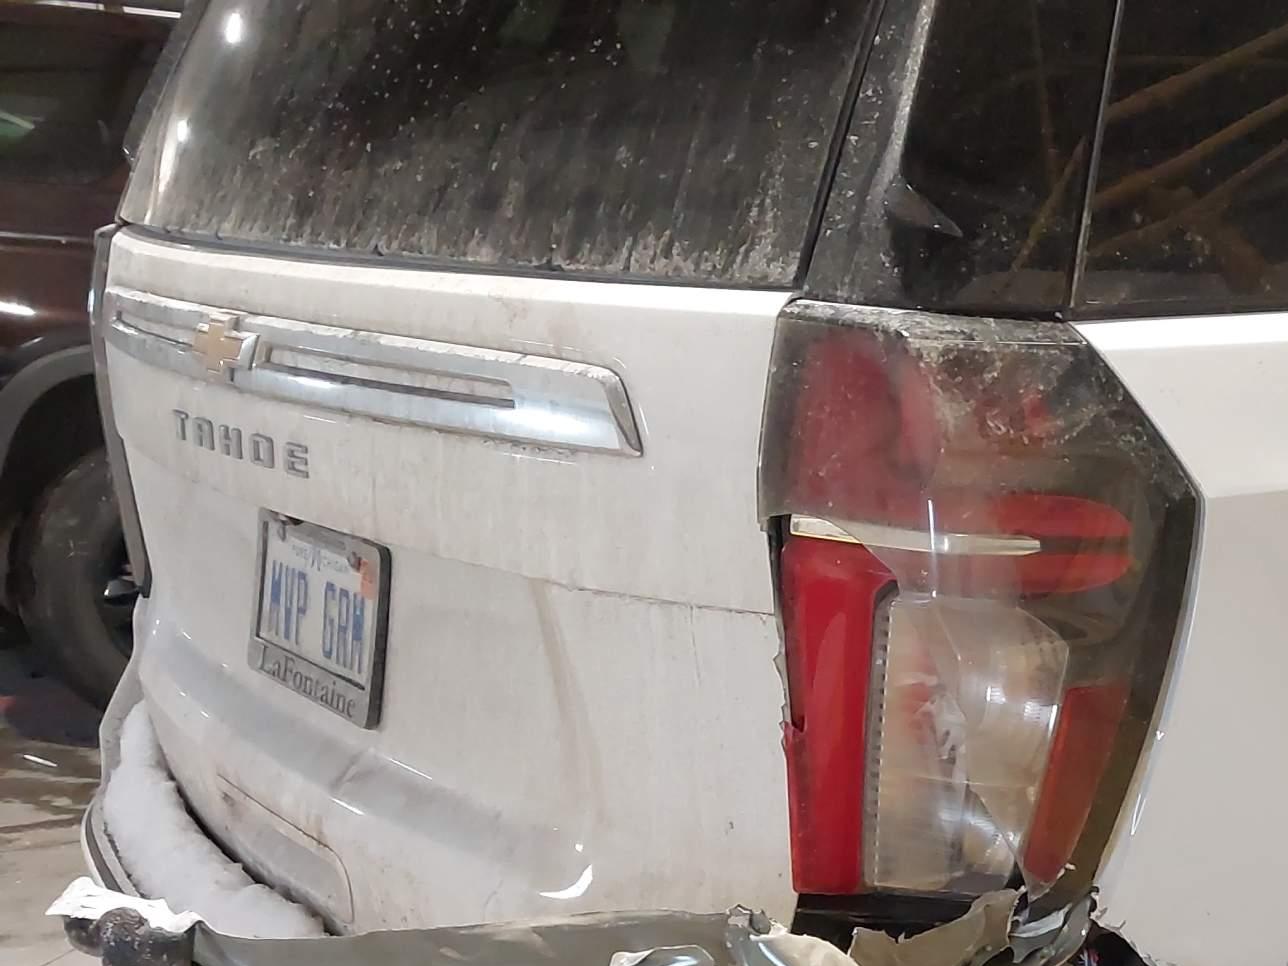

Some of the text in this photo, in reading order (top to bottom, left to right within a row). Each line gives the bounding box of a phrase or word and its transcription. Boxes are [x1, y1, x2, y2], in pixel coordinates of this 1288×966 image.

[173, 409, 309, 479] TAHOE
[268, 559, 308, 646] MVP
[259, 645, 356, 718] LaFontaine
